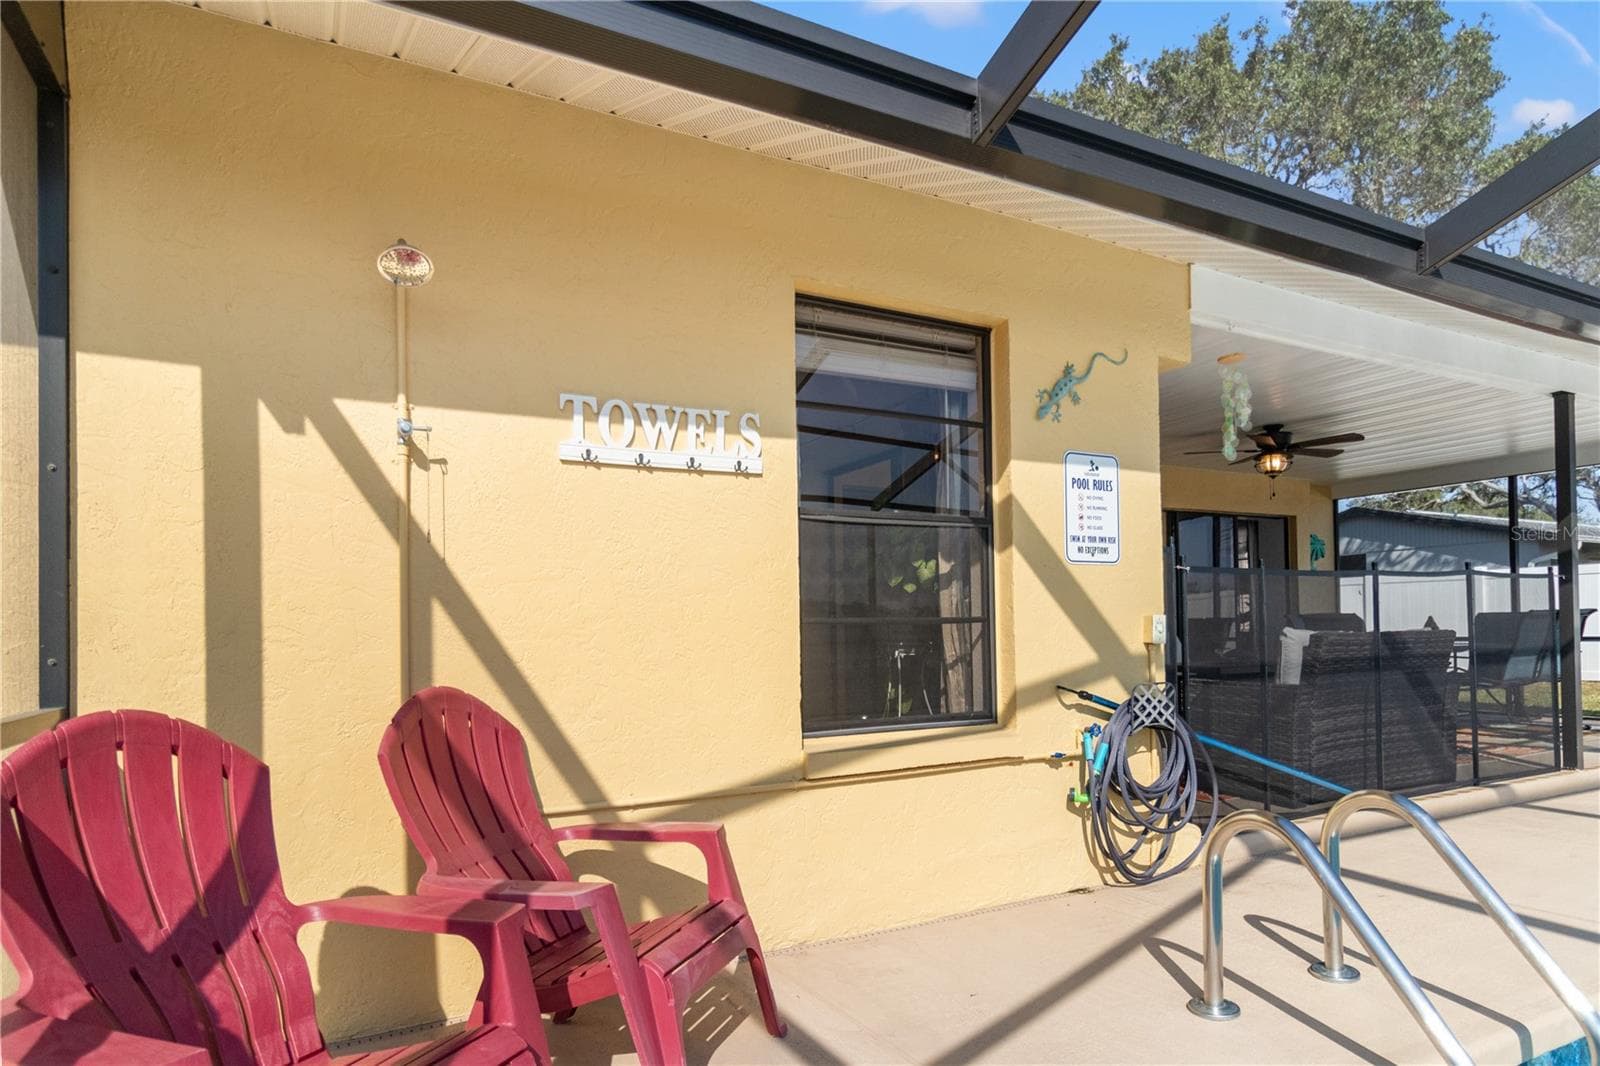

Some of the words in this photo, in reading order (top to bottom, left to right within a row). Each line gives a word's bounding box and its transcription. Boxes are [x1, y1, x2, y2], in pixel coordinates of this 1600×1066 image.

[559, 392, 762, 458] TOWELS
[1072, 477, 1090, 491] POOL
[1092, 479, 1113, 492] RULES
[1069, 534, 1080, 543] SWIM
[1087, 535, 1097, 543] YOUR
[1098, 536, 1107, 544] OWN
[1108, 536, 1117, 544] RISK
[1077, 546, 1084, 554] NO
[1085, 546, 1109, 555] EXCEPTIONS
